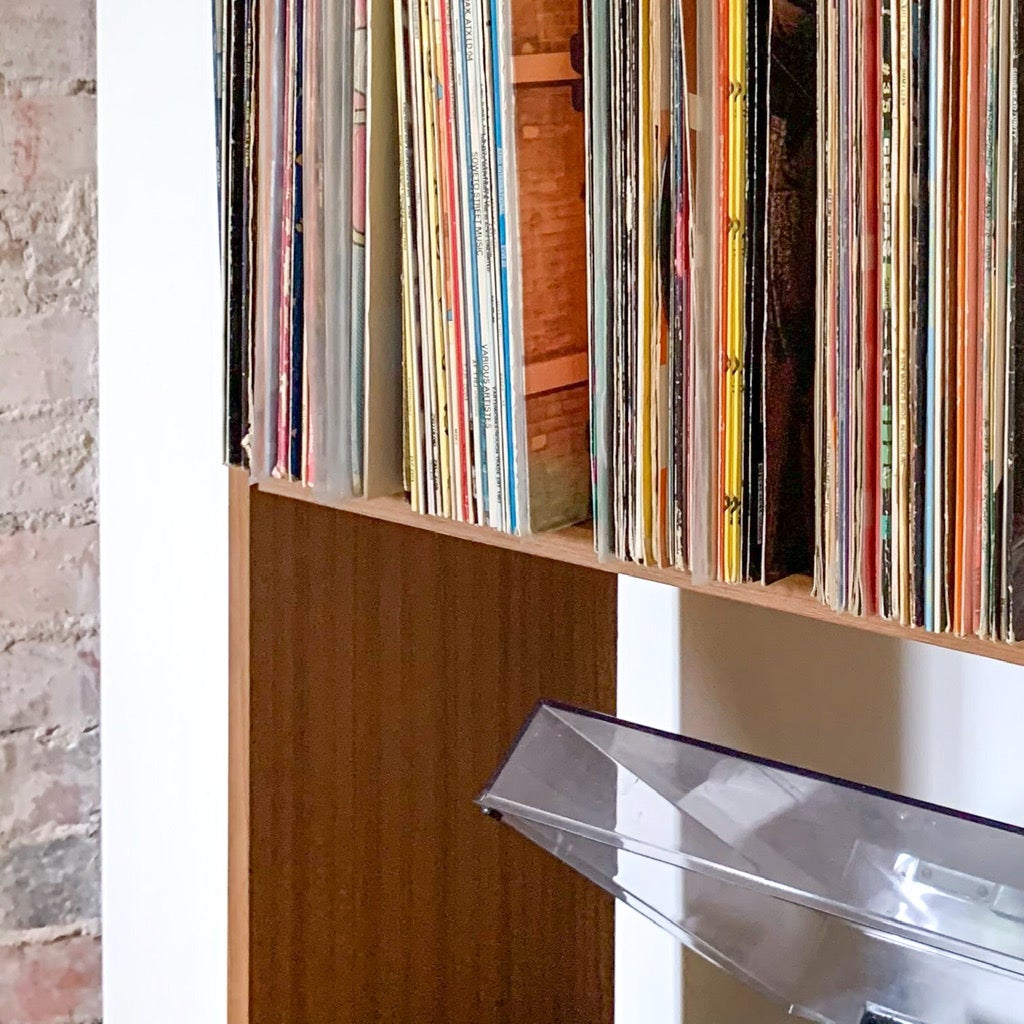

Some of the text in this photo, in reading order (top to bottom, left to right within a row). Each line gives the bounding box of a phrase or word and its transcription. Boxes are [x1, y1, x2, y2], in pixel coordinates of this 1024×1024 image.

[472, 151, 484, 257] SOWETO STREET MUSIC
[482, 344, 493, 430] VARIOUS ARTISTES
